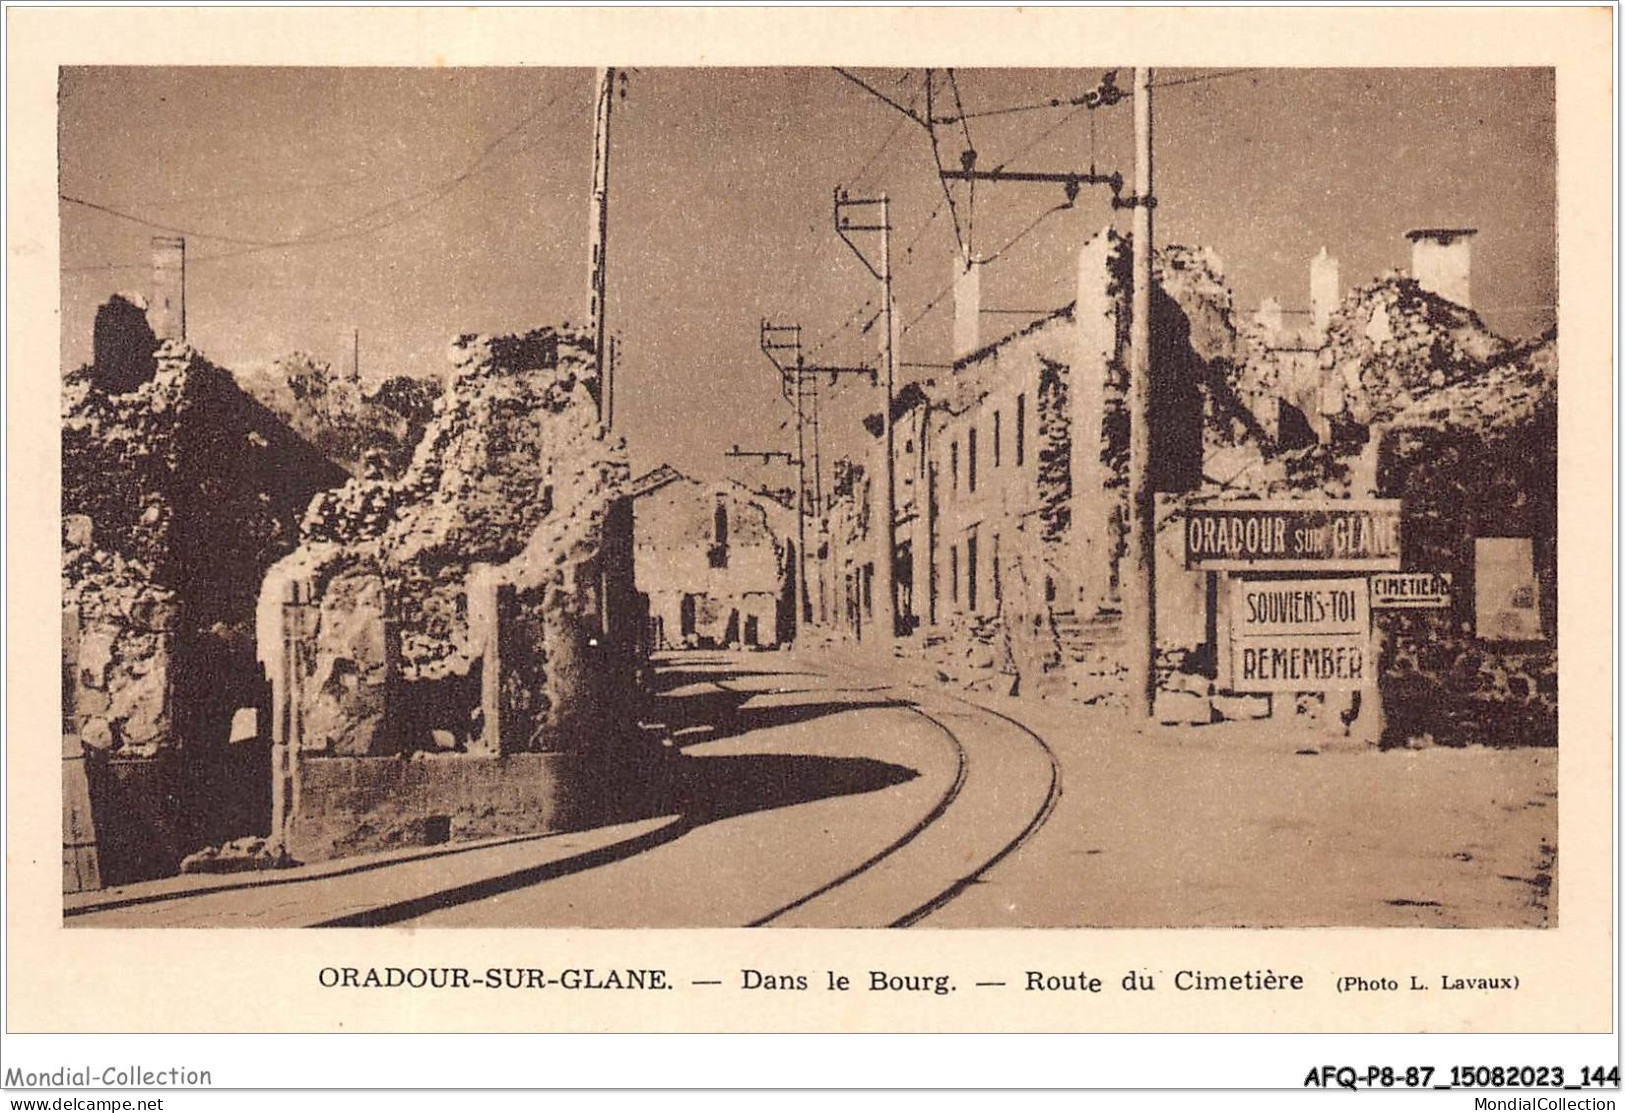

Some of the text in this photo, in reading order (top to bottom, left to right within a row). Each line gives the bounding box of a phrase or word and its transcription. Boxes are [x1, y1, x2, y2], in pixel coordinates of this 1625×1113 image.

[1189, 516, 1285, 554] ORADOUR
[1246, 590, 1356, 624] SOUVIENS-TOI
[1243, 646, 1362, 679] REMEMBER
